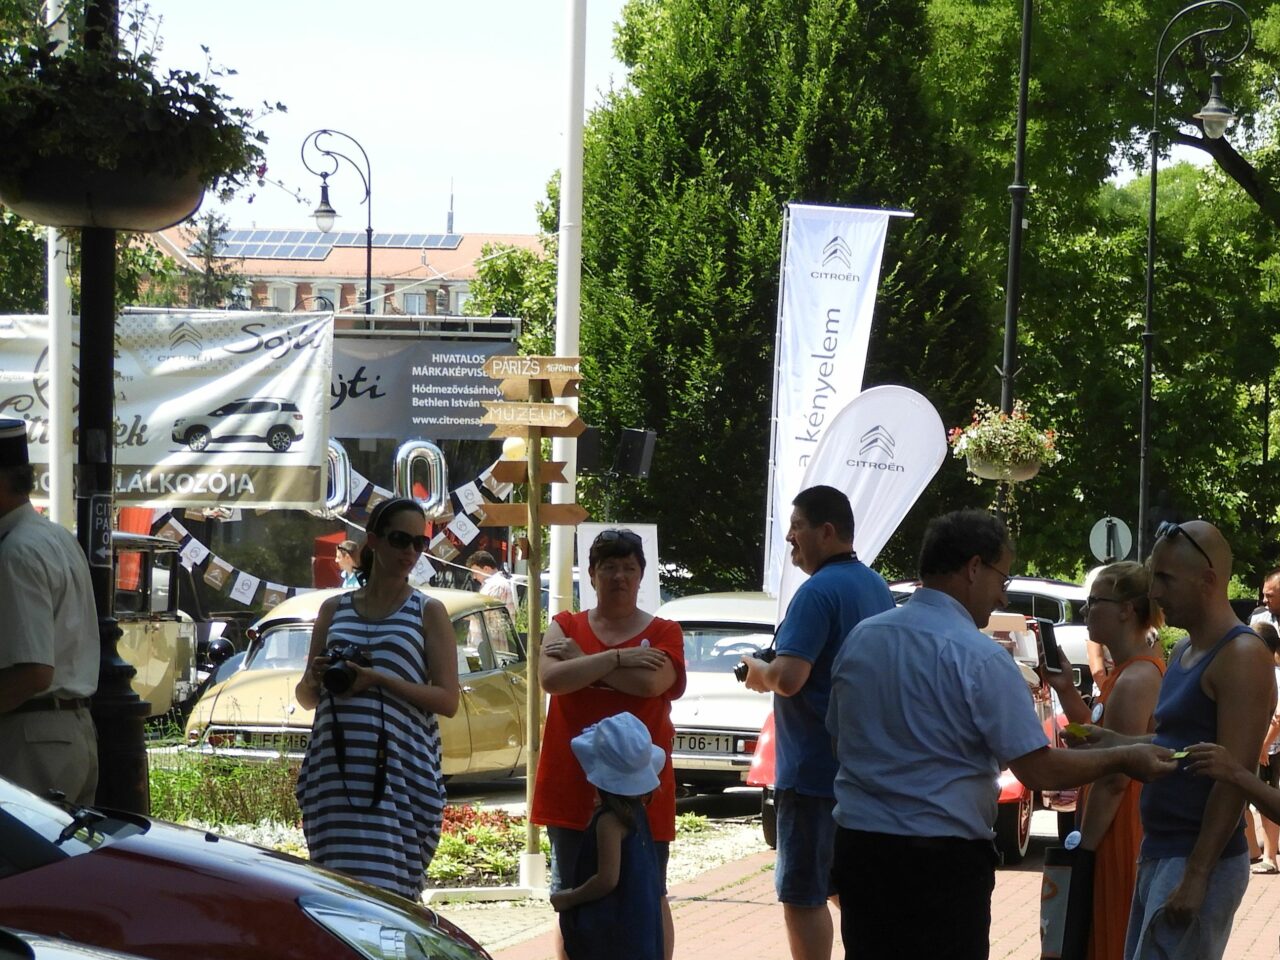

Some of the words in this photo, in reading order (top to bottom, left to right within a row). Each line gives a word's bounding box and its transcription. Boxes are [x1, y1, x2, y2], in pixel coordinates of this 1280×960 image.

[432, 353, 486, 364] HIVATALOS
[795, 307, 841, 443] kényelem
[412, 397, 450, 408] Bethlen
[451, 397, 480, 408] István
[412, 415, 484, 427] www.citroensaj
[688, 736, 729, 751] 06-11
